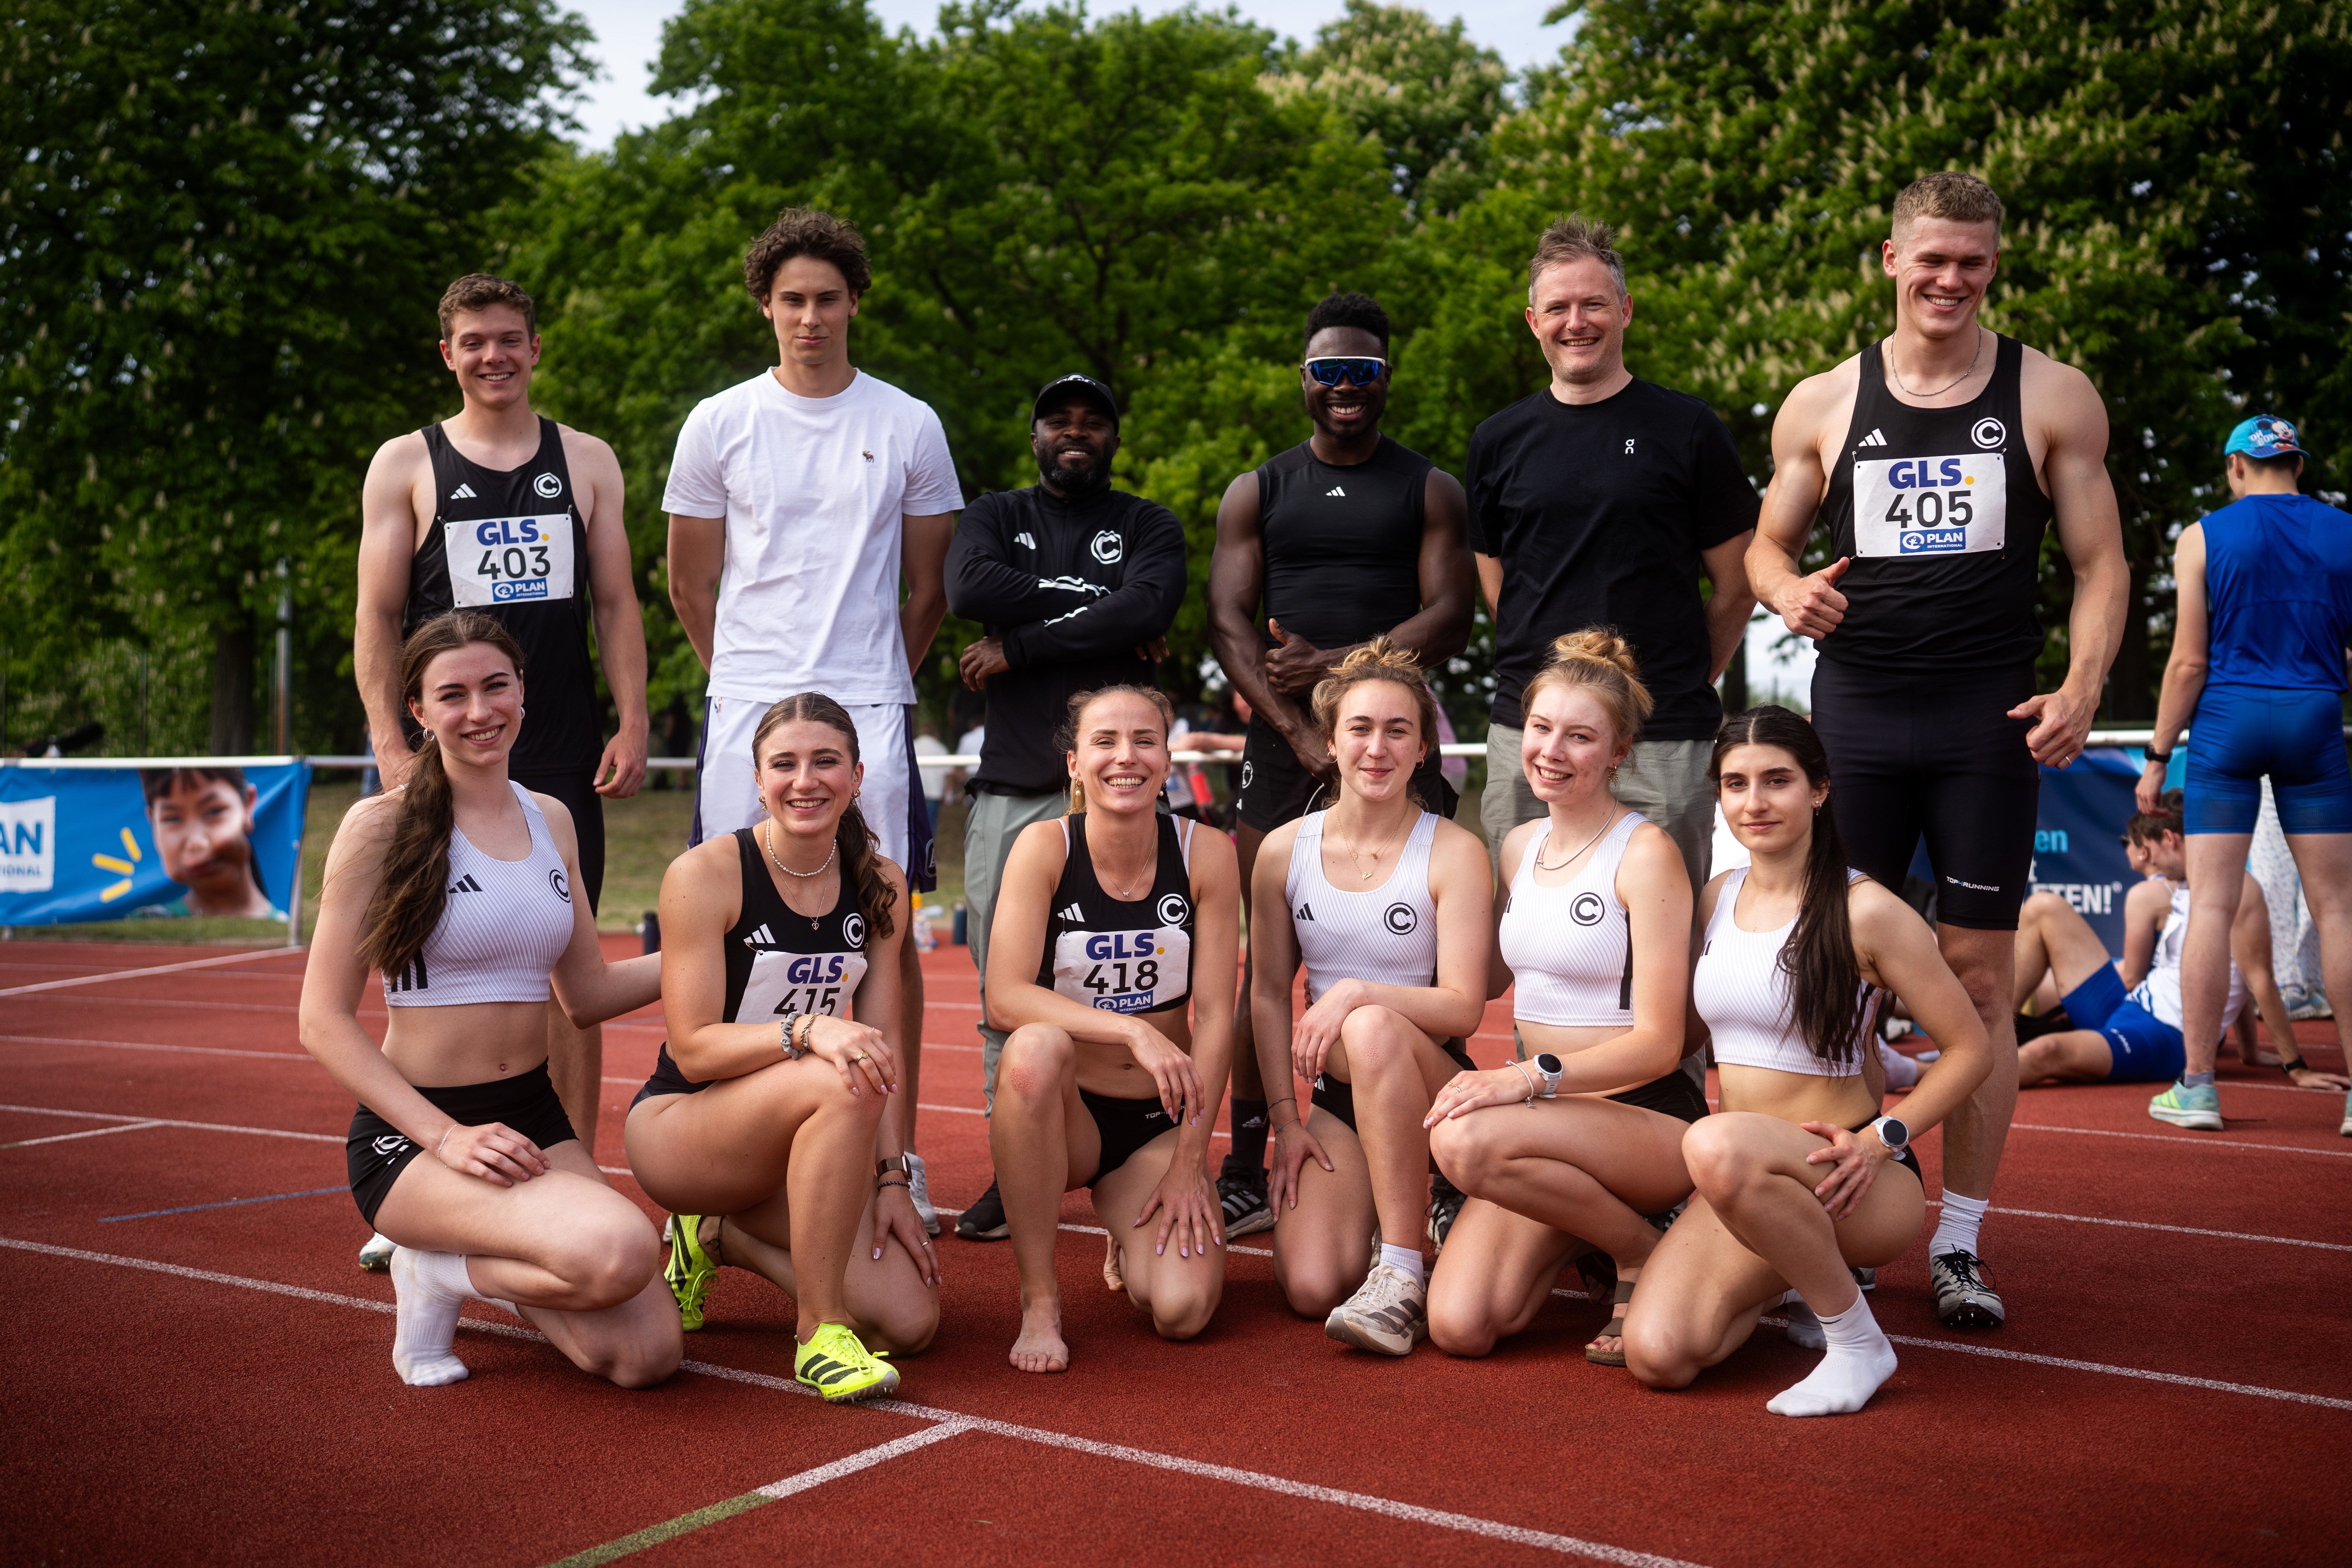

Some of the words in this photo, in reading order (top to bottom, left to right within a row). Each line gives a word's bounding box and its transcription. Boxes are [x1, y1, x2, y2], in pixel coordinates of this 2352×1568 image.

[2250, 429, 2263, 442] OH
[1885, 490, 1973, 528] 405
[1927, 532, 1963, 543] PLAN
[478, 546, 551, 580] 403
[515, 581, 545, 593] PLAN
[1947, 876, 2000, 892] TOP4RUNNING
[1083, 960, 1159, 995] 418
[773, 987, 841, 1018] 415
[1119, 995, 1151, 1008] PLAN
